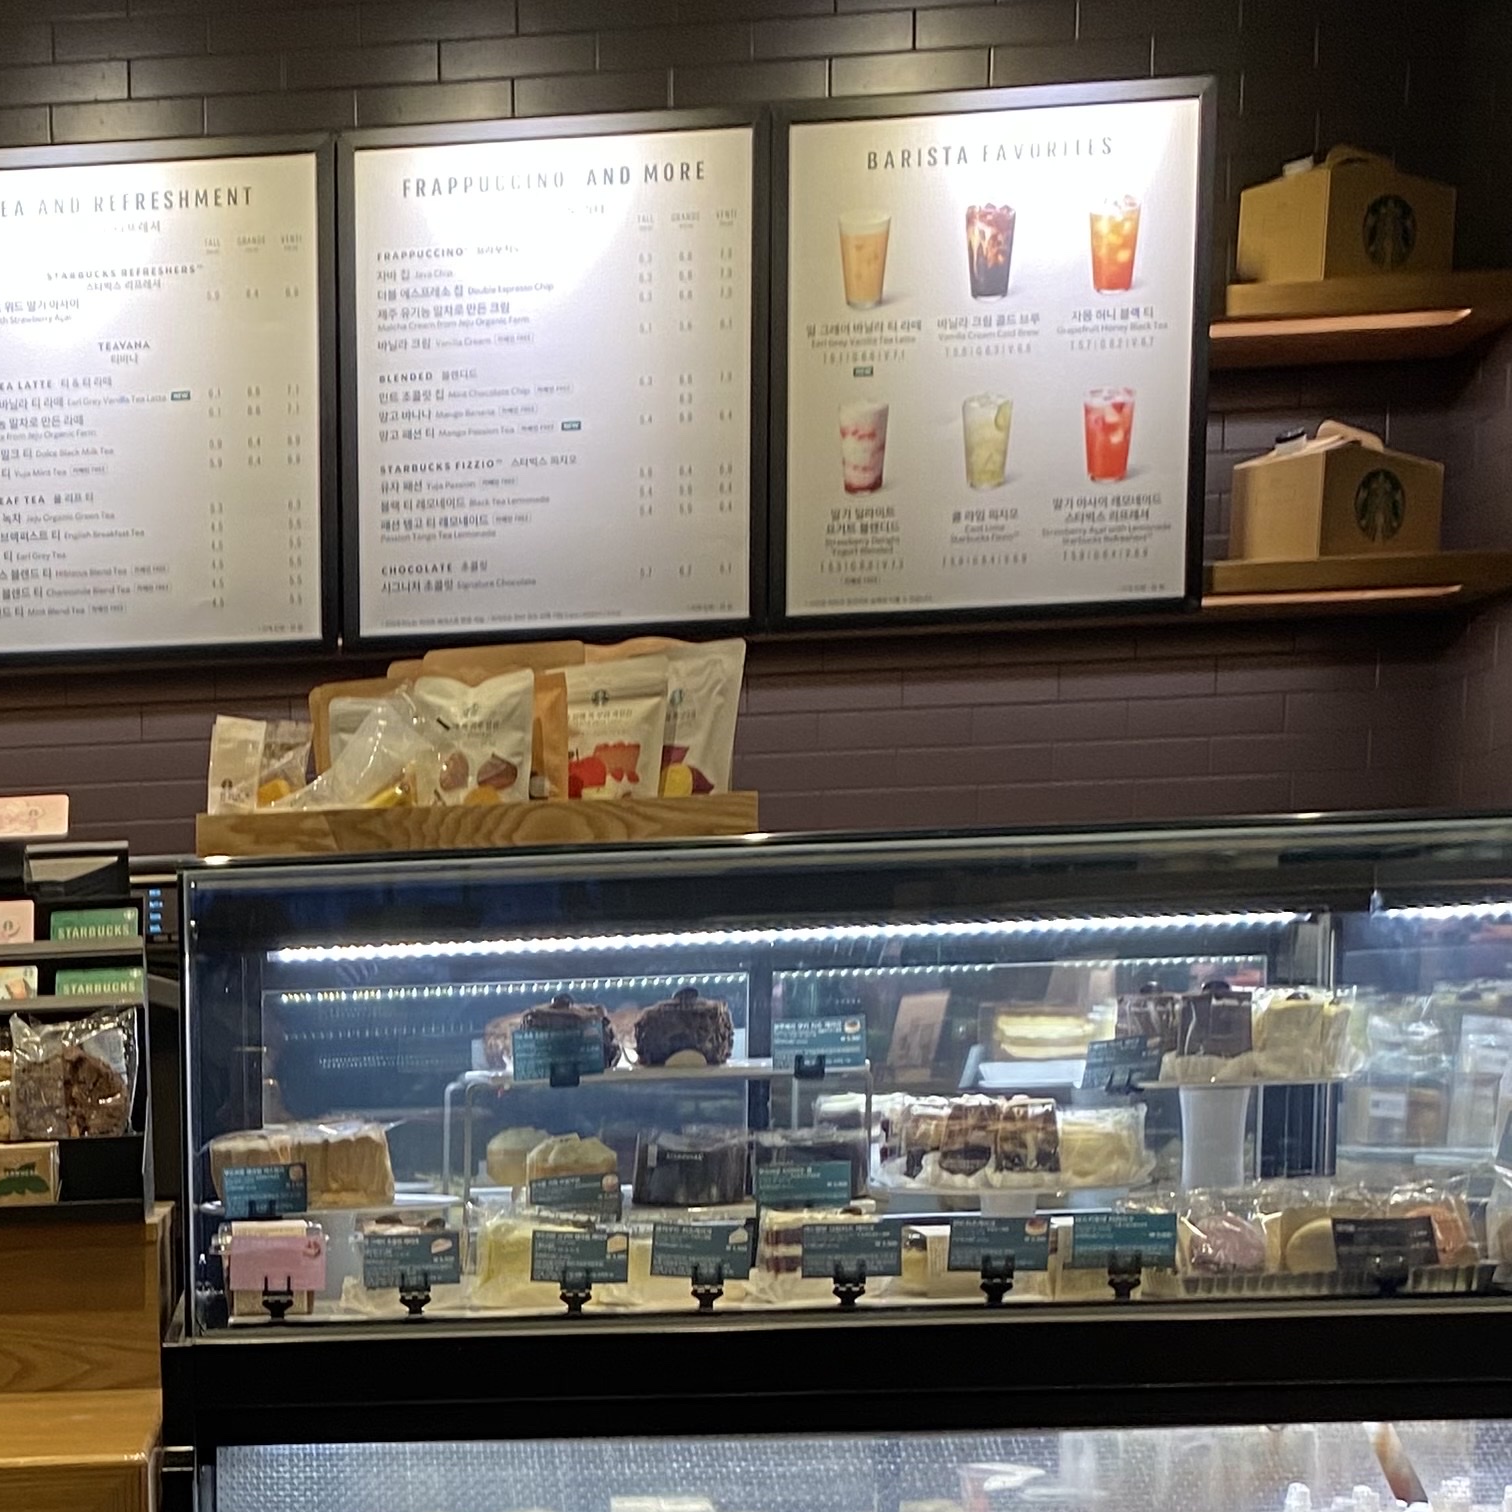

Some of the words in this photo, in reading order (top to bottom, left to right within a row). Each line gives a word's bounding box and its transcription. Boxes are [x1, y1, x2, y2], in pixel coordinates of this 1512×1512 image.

[867, 146, 969, 171] BARISTA
[402, 171, 564, 198] FRAPPUCCINO
[587, 166, 631, 187] AND
[643, 160, 705, 184] MORE
[38, 197, 80, 215] AND
[94, 186, 253, 214] REFRESHMENT
[400, 285, 450, 299] 에스프레소
[454, 285, 463, 297] 칩
[401, 307, 429, 318] 유기농
[1144, 306, 1154, 318] 티
[98, 341, 150, 351] TEAVANA
[377, 339, 407, 351] 바닐라
[379, 372, 433, 384] BLENDED
[17, 380, 52, 390] LATTE
[426, 427, 435, 438] 티
[23, 449, 32, 460] 티
[2, 467, 11, 479] 티
[380, 462, 451, 475] STARBUCKS
[25, 495, 45, 504] TEA
[85, 492, 94, 502] 티
[403, 499, 413, 511] 티
[416, 497, 465, 510] 레모네이드
[427, 516, 435, 528] 티
[439, 515, 488, 528] 레모네이드
[43, 568, 52, 579] 티
[381, 563, 452, 576] CHOCOLATE
[14, 606, 24, 618] 티
[58, 926, 130, 940] STARBUCKS
[63, 981, 136, 995] STARBUCKS
